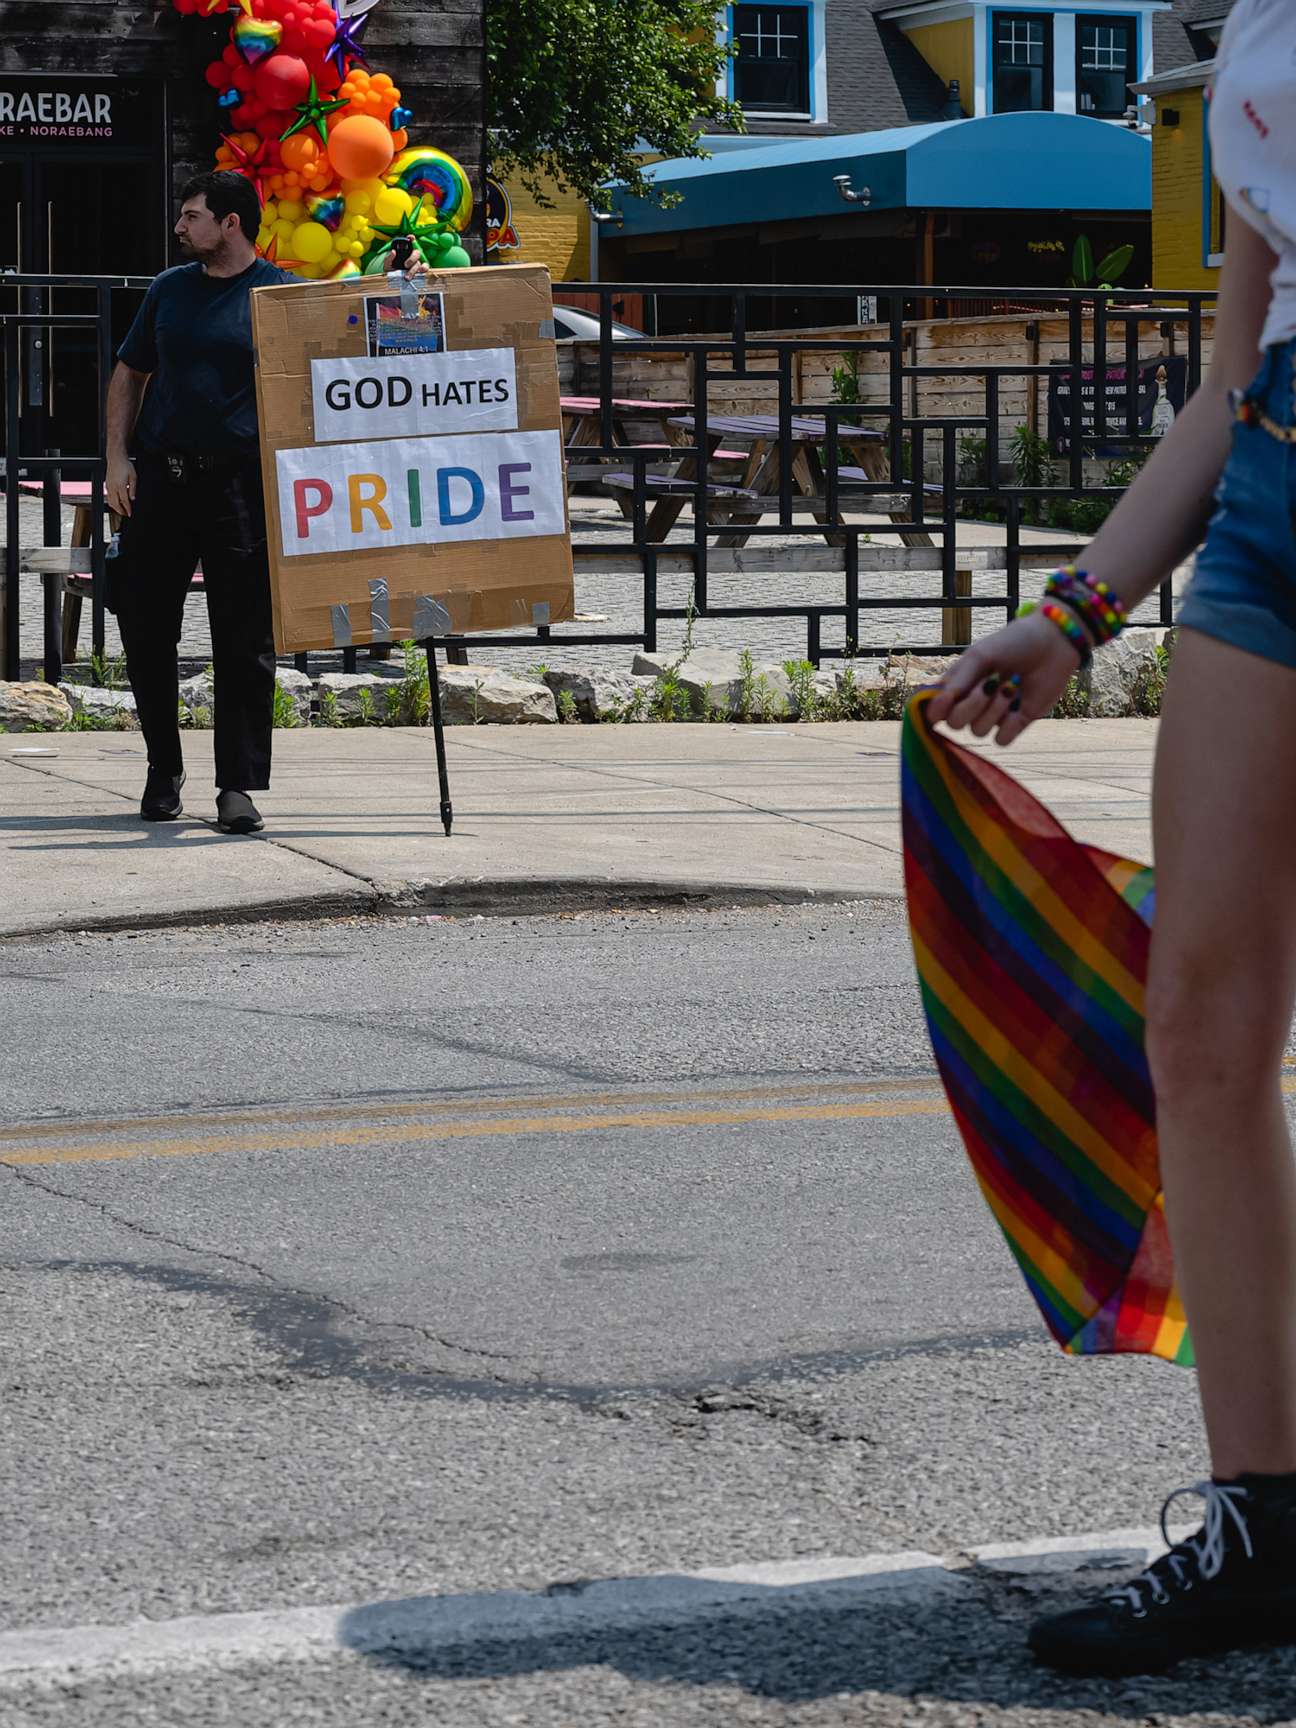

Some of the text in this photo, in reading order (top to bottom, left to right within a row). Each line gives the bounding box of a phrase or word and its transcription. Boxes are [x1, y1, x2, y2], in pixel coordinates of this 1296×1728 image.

[0, 92, 112, 123] RAEBAR
[30, 126, 113, 136] NORAEBANG
[385, 347, 418, 355] MALACHI
[325, 376, 509, 411] GOD HATES
[293, 462, 535, 538] PRIDE
